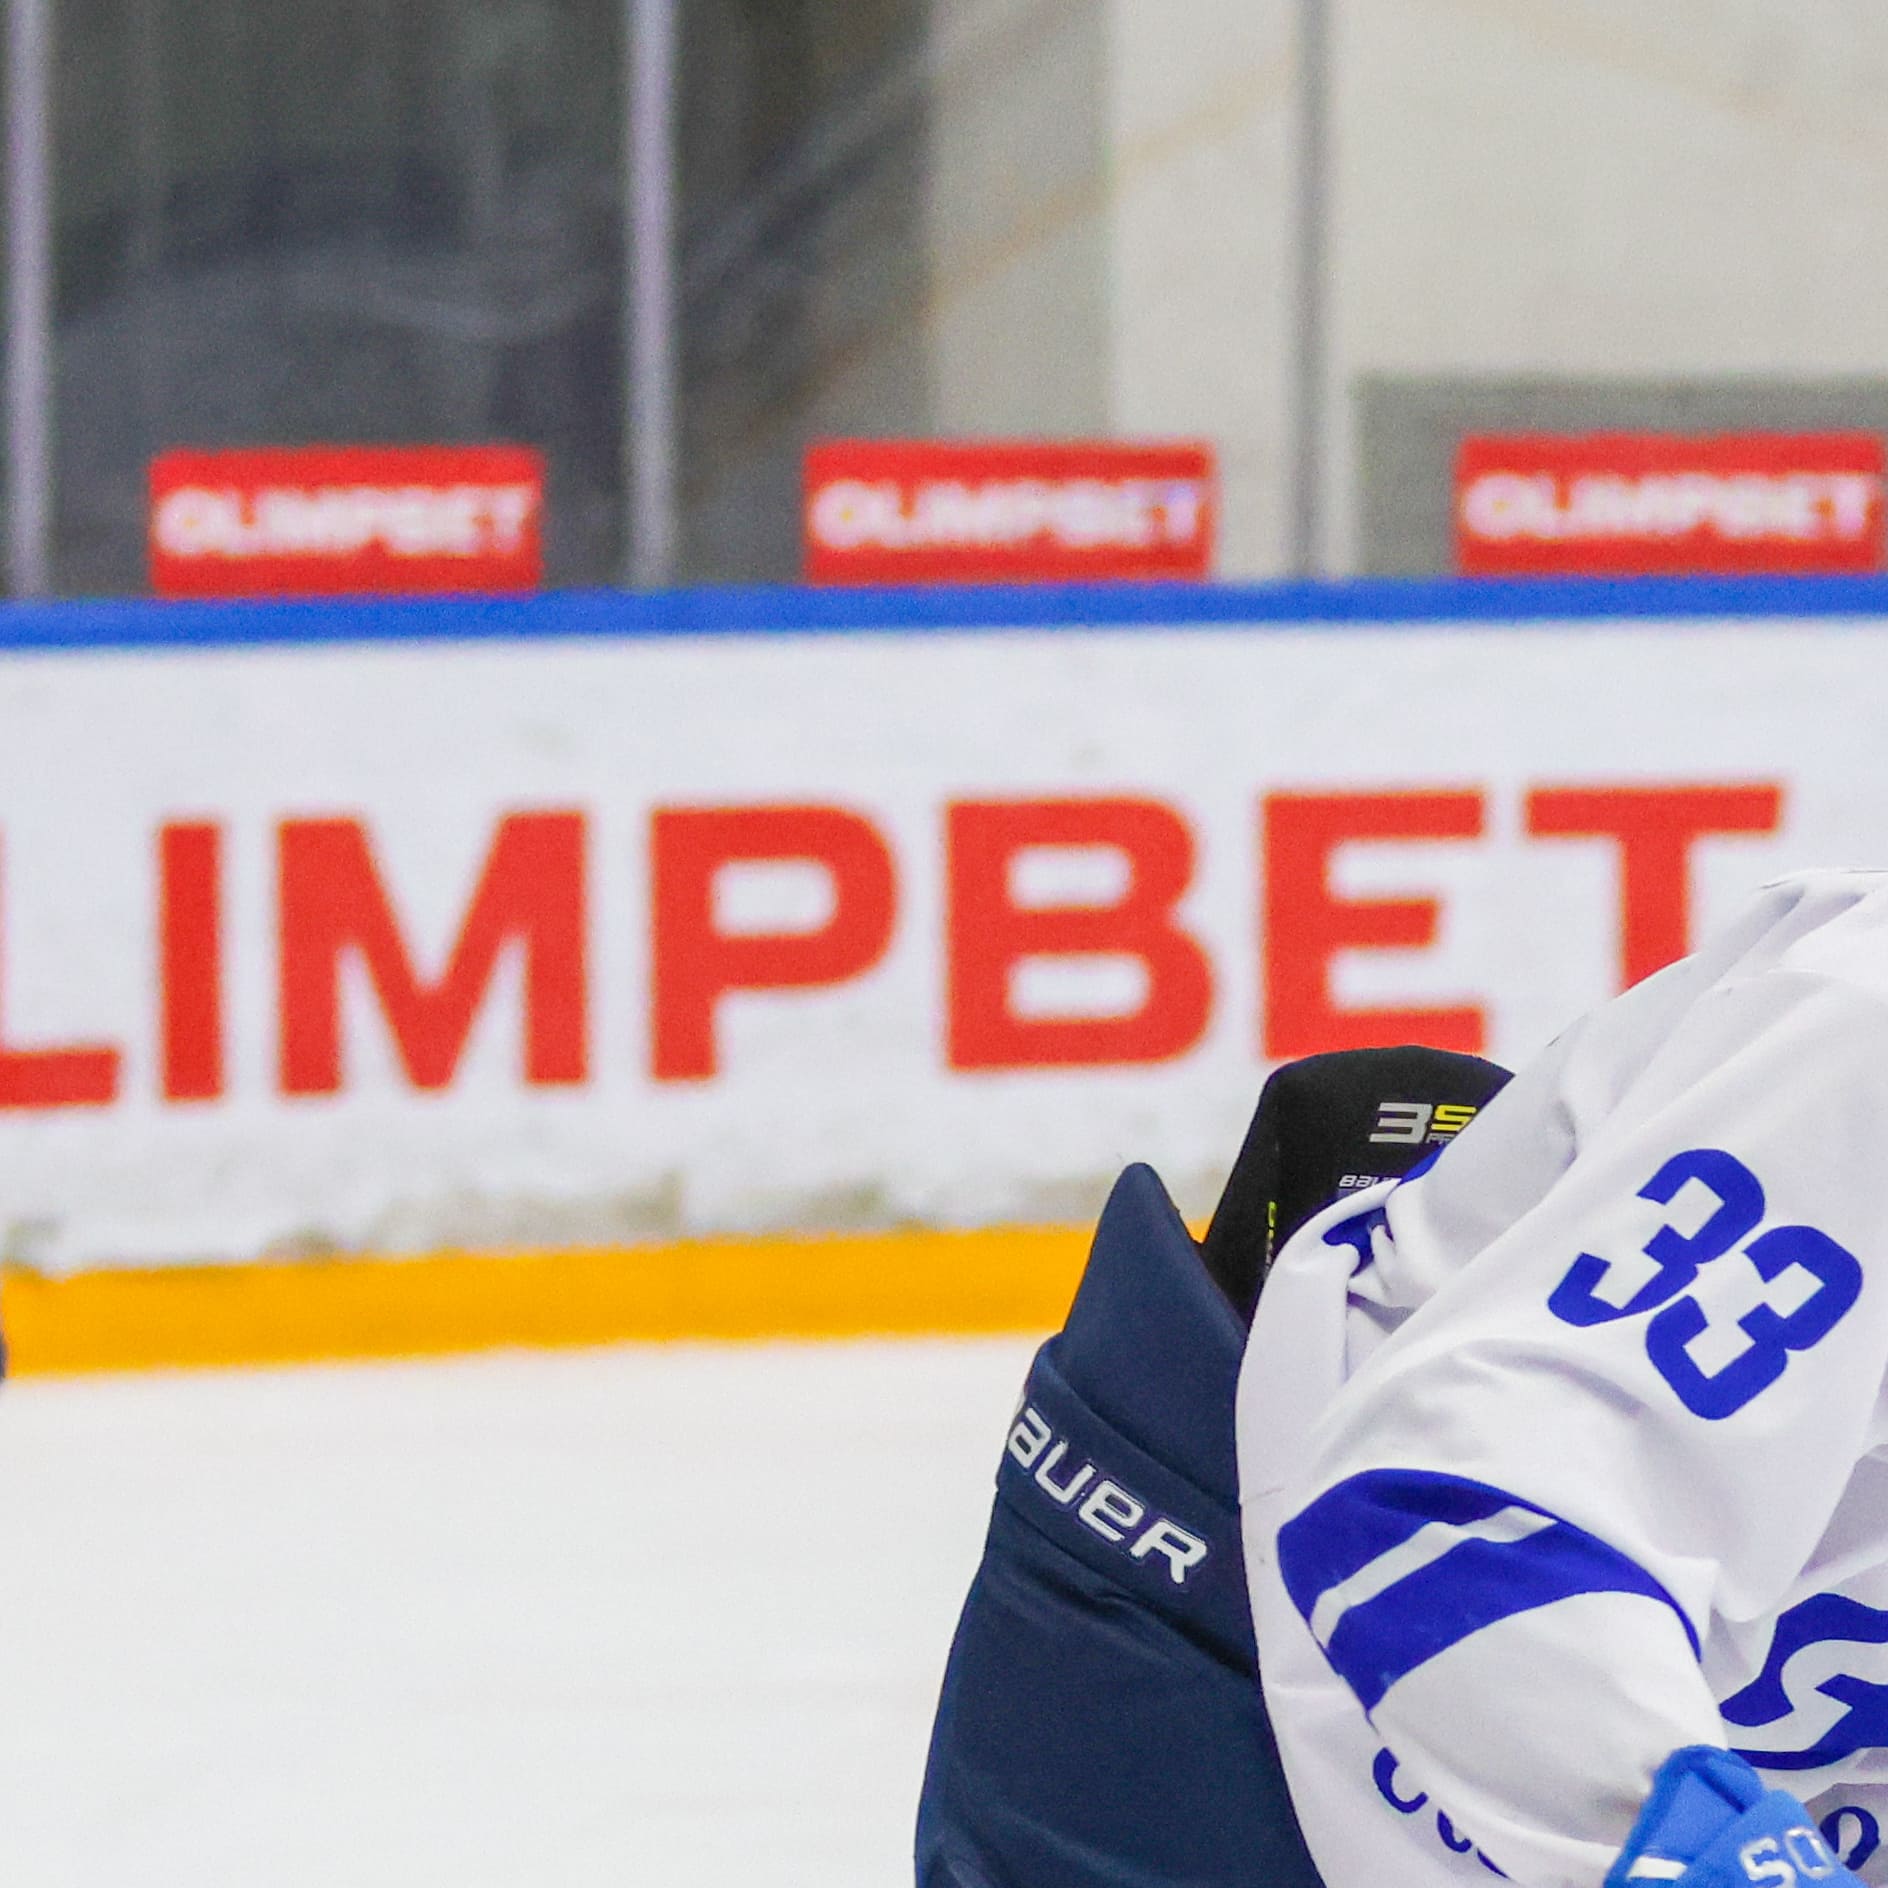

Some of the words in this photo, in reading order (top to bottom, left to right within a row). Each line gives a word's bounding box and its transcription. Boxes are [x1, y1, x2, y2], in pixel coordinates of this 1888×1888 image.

[154, 486, 536, 558] OLIMPBET
[812, 479, 1200, 550] OLIMPBET
[1462, 472, 1876, 541] OLIMPBET
[1547, 1148, 1863, 1421] 33
[1008, 1407, 1207, 1583] AUER
